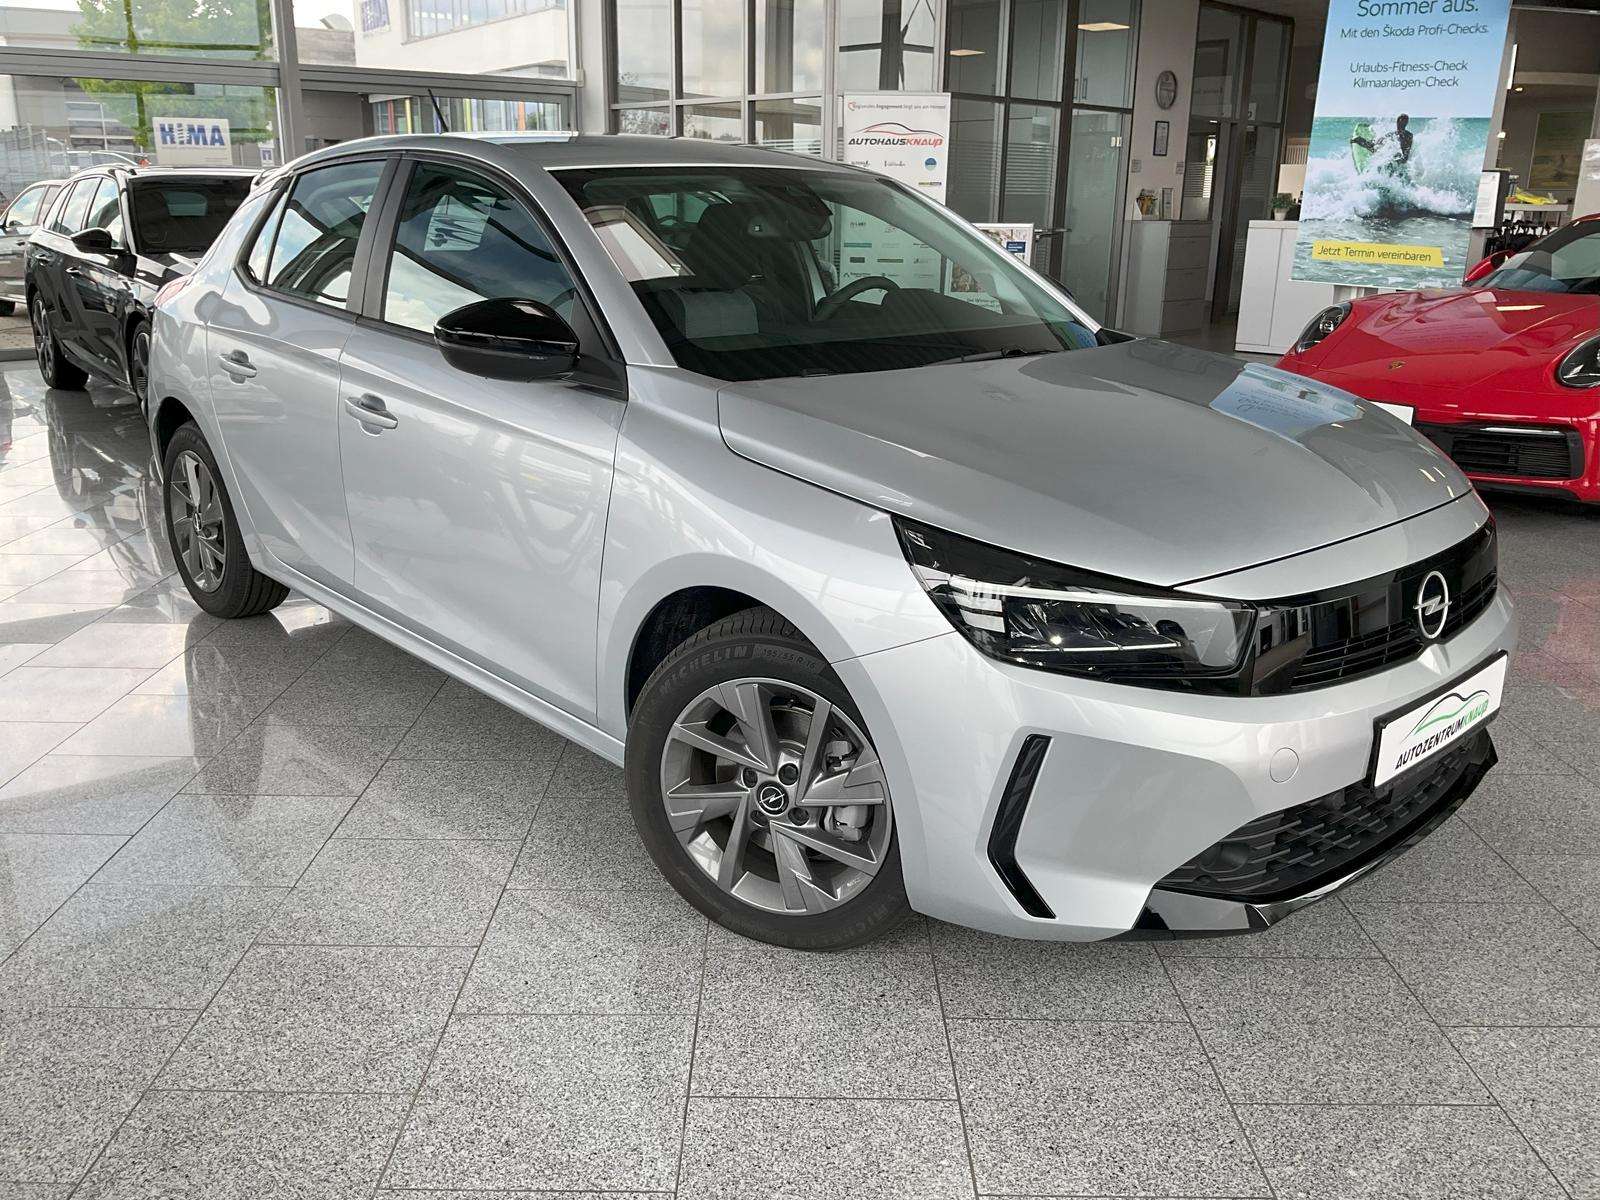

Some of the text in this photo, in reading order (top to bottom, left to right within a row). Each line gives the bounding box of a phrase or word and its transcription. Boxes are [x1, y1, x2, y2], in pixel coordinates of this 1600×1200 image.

[1357, 0, 1479, 17] Sommer aus.
[1340, 22, 1490, 39] Mit den Škoda Profi-Checks.
[1350, 60, 1469, 74] Urlaubs-Fitness-Check
[1353, 76, 1460, 91] Klimaanlagen-Check
[159, 122, 226, 146] HIMA
[1318, 245, 1432, 262] Jetzt Termin vereinbaren
